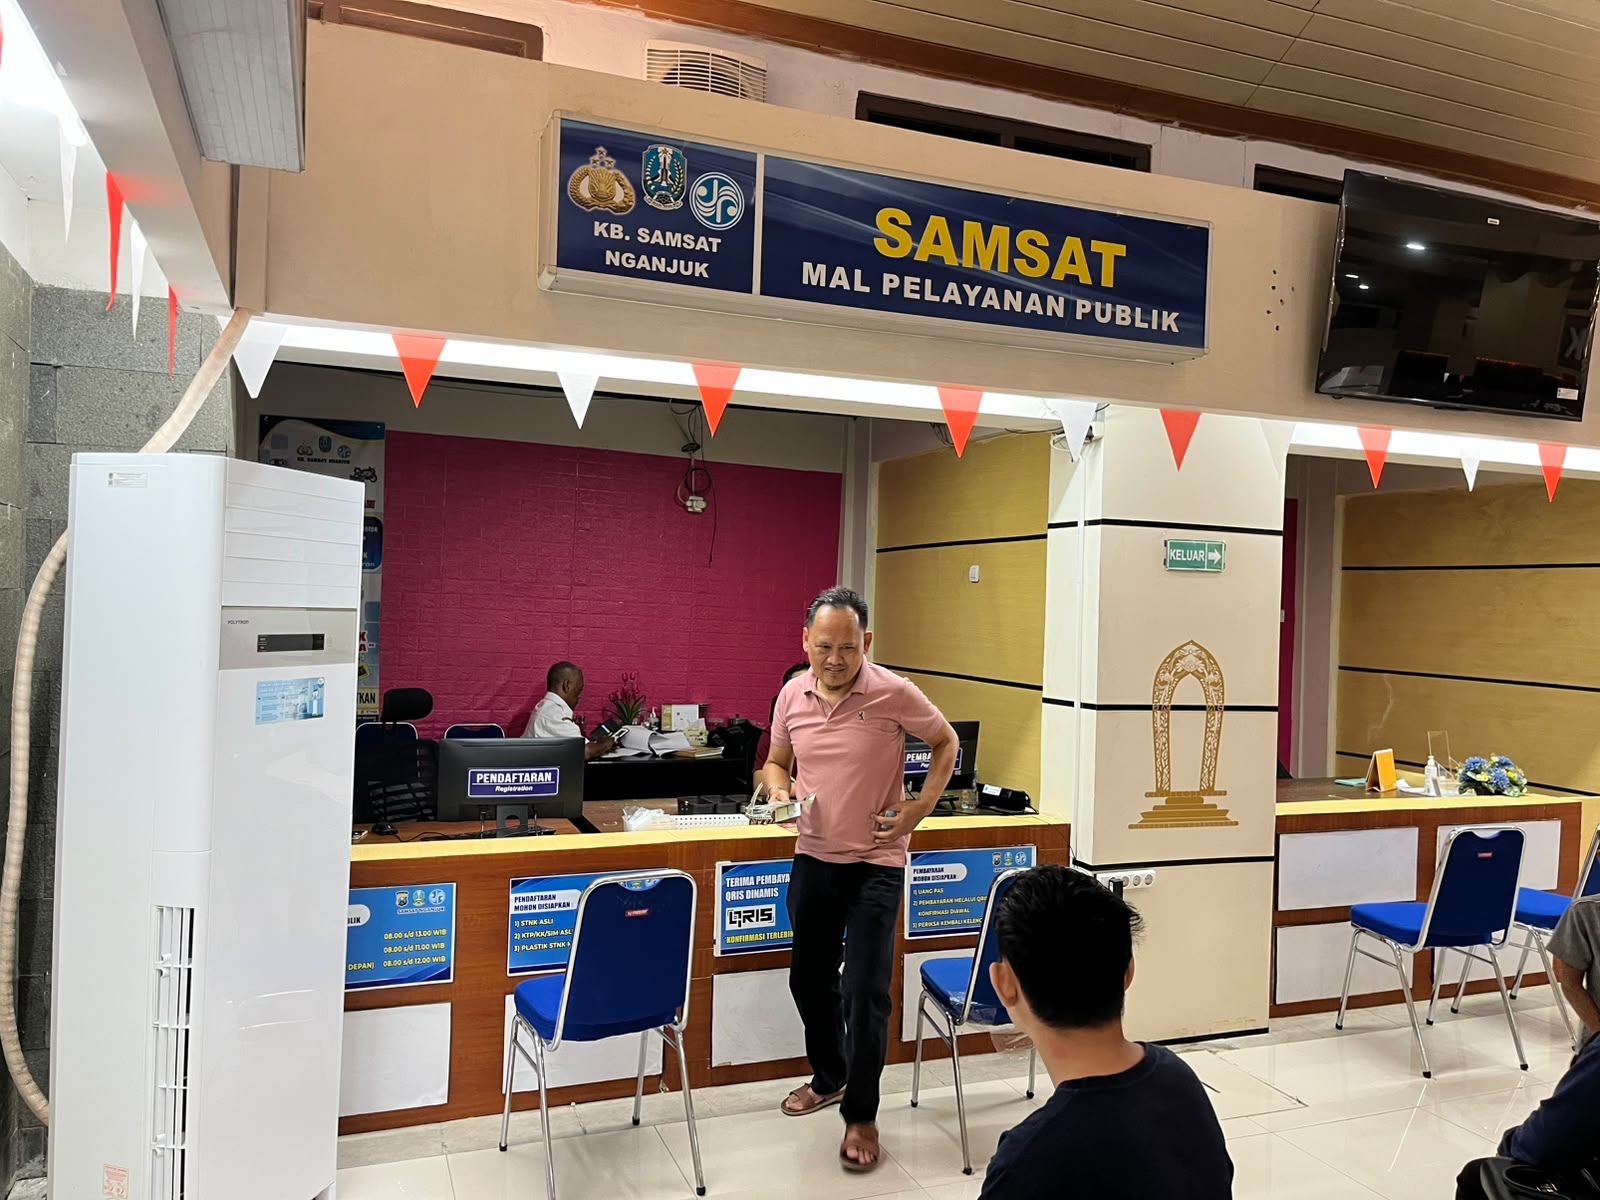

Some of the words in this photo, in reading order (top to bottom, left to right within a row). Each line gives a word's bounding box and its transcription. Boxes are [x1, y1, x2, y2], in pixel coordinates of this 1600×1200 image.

[593, 221, 630, 241] KB.
[637, 227, 722, 253] SAMSAT
[873, 207, 1127, 288] SAMSAT
[605, 249, 710, 278] NGANJUK
[802, 261, 871, 293] MAL
[882, 272, 1065, 318] PELAYANAN
[1075, 298, 1180, 333] PUBLIK
[1170, 548, 1205, 562] KELUAR
[476, 772, 552, 783] PENDAFTARAN
[495, 785, 533, 793] Registration
[725, 876, 755, 888] TERIMA
[756, 873, 791, 886] PEMBAYA
[514, 894, 557, 903] PENDAFTARAN
[725, 889, 744, 902] QRIS
[745, 887, 779, 900] DINAMIS
[514, 903, 537, 912] MOHON
[537, 901, 571, 911] DISIAPKAN
[918, 898, 954, 907] PEMBAYARAN
[514, 920, 520, 928] 1)
[521, 919, 538, 927] STNK
[728, 908, 774, 928] QRIS
[383, 931, 403, 940] 08.00
[403, 930, 415, 939] s/d
[415, 928, 432, 938] 13.00
[433, 928, 447, 936] WIB
[514, 932, 520, 940] 2)
[521, 930, 559, 939] KTP/KK/SIM
[726, 933, 765, 944] KONFIRMASI
[383, 945, 403, 954] 08.00
[403, 944, 415, 953] s/d
[415, 943, 430, 952] 11.00
[431, 942, 446, 950] WIB
[521, 943, 548, 952] PLASTIK
[549, 942, 567, 950] STNK
[348, 962, 375, 970] DEPAN)
[383, 959, 403, 968] 08.00
[403, 957, 414, 966] s/d
[414, 956, 431, 965] 12.00
[431, 955, 446, 963] WIB
